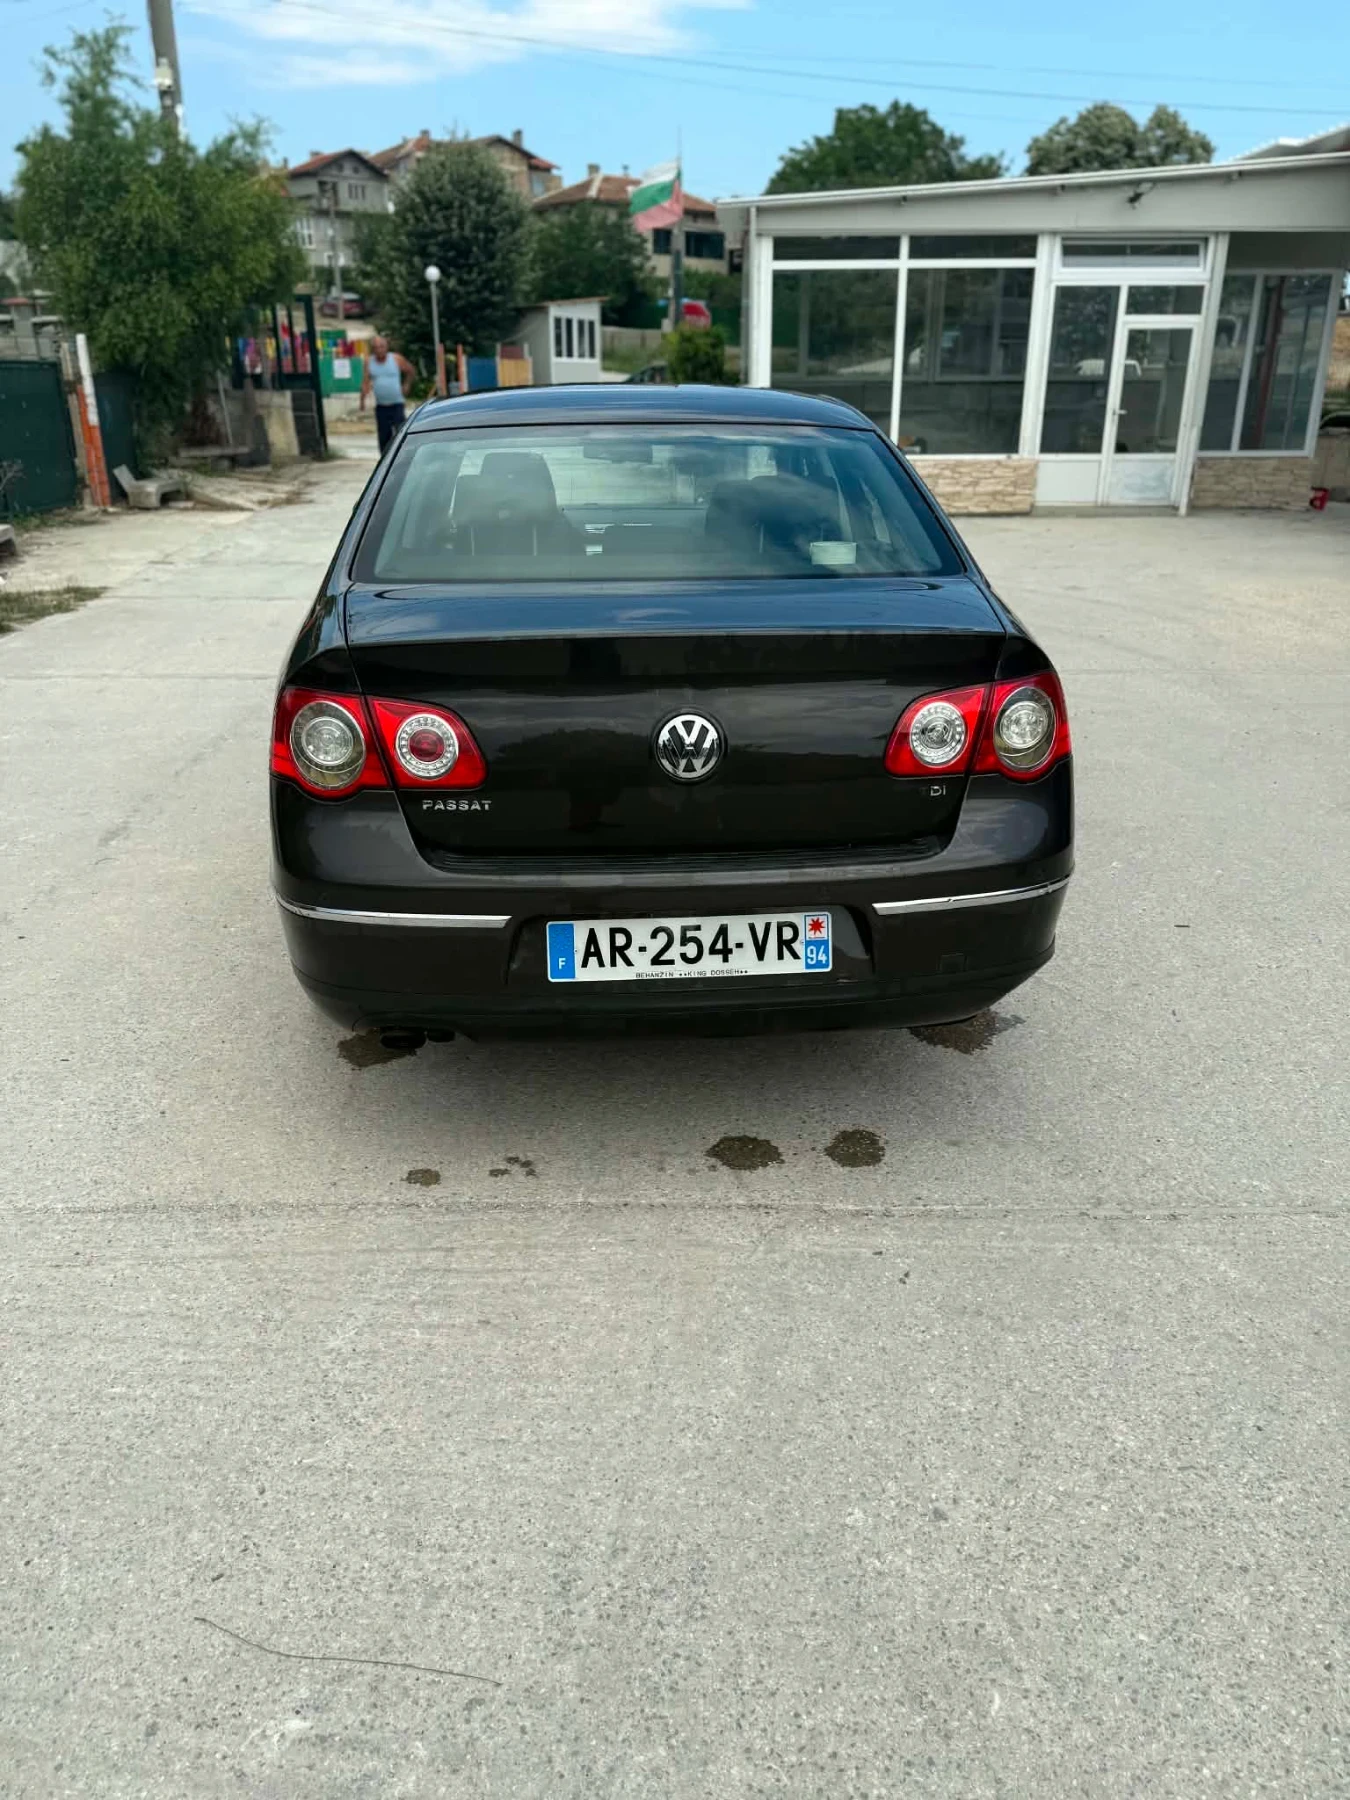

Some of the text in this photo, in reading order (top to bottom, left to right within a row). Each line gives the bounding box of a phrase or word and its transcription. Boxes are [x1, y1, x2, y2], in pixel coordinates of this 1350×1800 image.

[422, 799, 492, 811] PASSAT
[580, 921, 802, 968] AR-254-VR
[807, 945, 828, 965] 94
[558, 958, 566, 969] F
